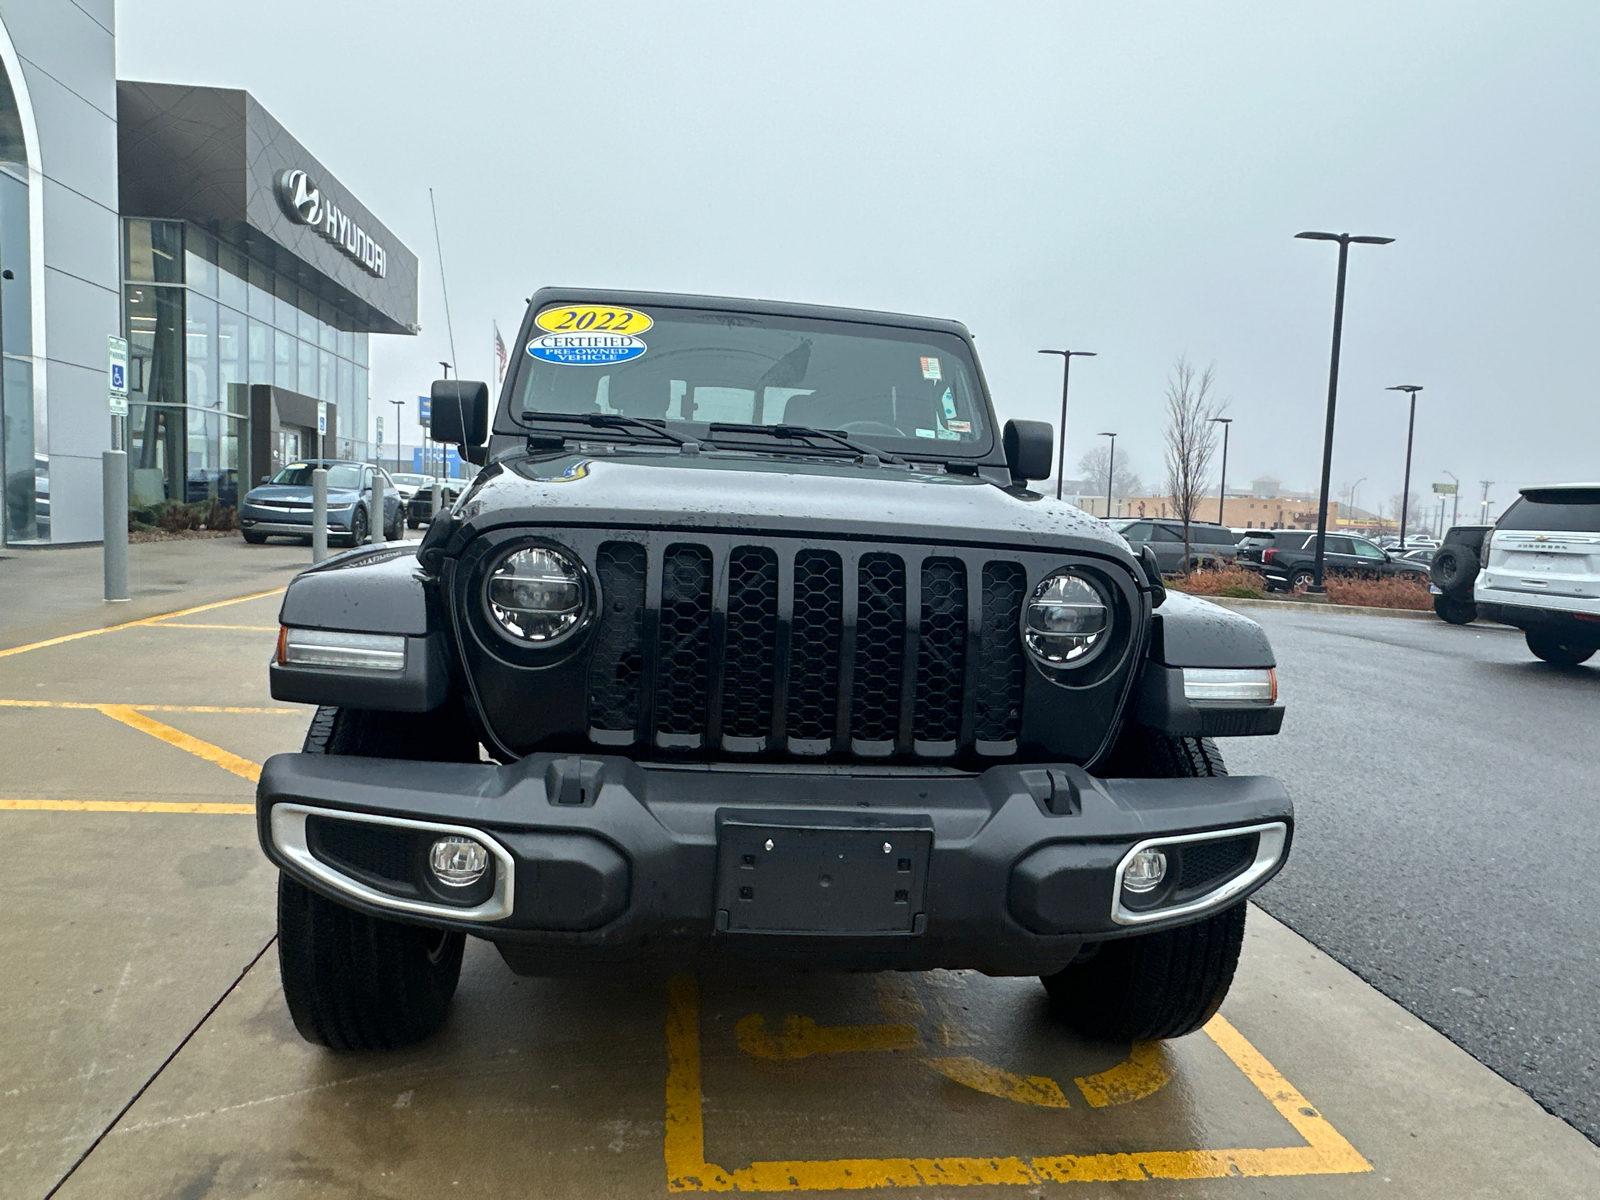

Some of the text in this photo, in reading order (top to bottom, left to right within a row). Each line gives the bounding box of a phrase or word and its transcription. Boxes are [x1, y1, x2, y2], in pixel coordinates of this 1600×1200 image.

[326, 199, 387, 279] HYUNDAI
[554, 311, 634, 330] 2022
[541, 337, 633, 347] CERTIFIED
[109, 350, 127, 361] PARKING
